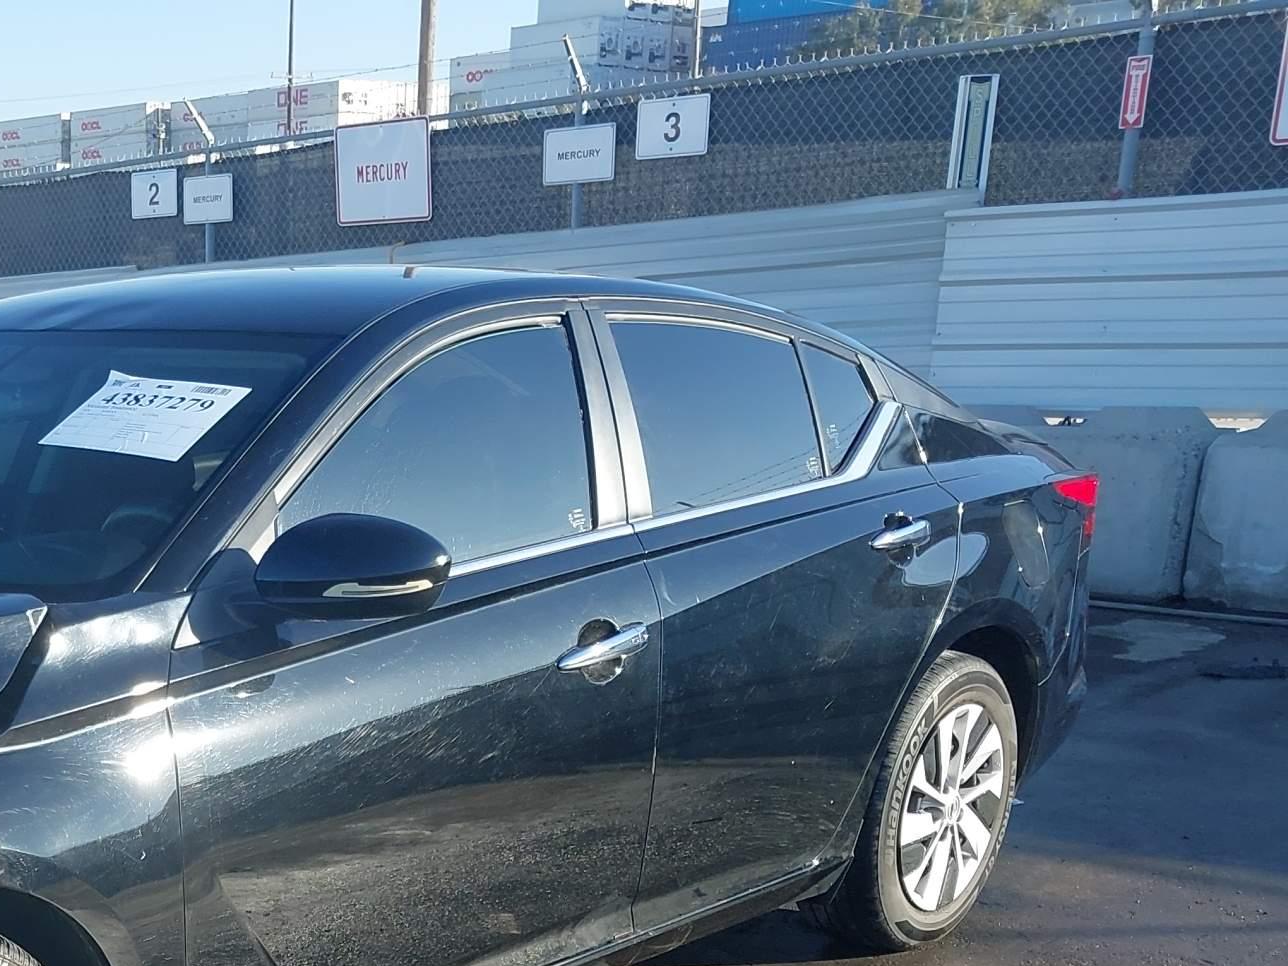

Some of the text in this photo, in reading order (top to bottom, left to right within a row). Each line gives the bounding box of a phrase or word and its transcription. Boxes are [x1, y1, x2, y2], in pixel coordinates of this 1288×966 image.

[663, 112, 681, 143] 3
[557, 148, 601, 162] MERCURY
[356, 161, 408, 184] MERCURY
[148, 182, 160, 206] 2
[192, 194, 224, 205] MERCURY
[100, 391, 216, 413] 43837279
